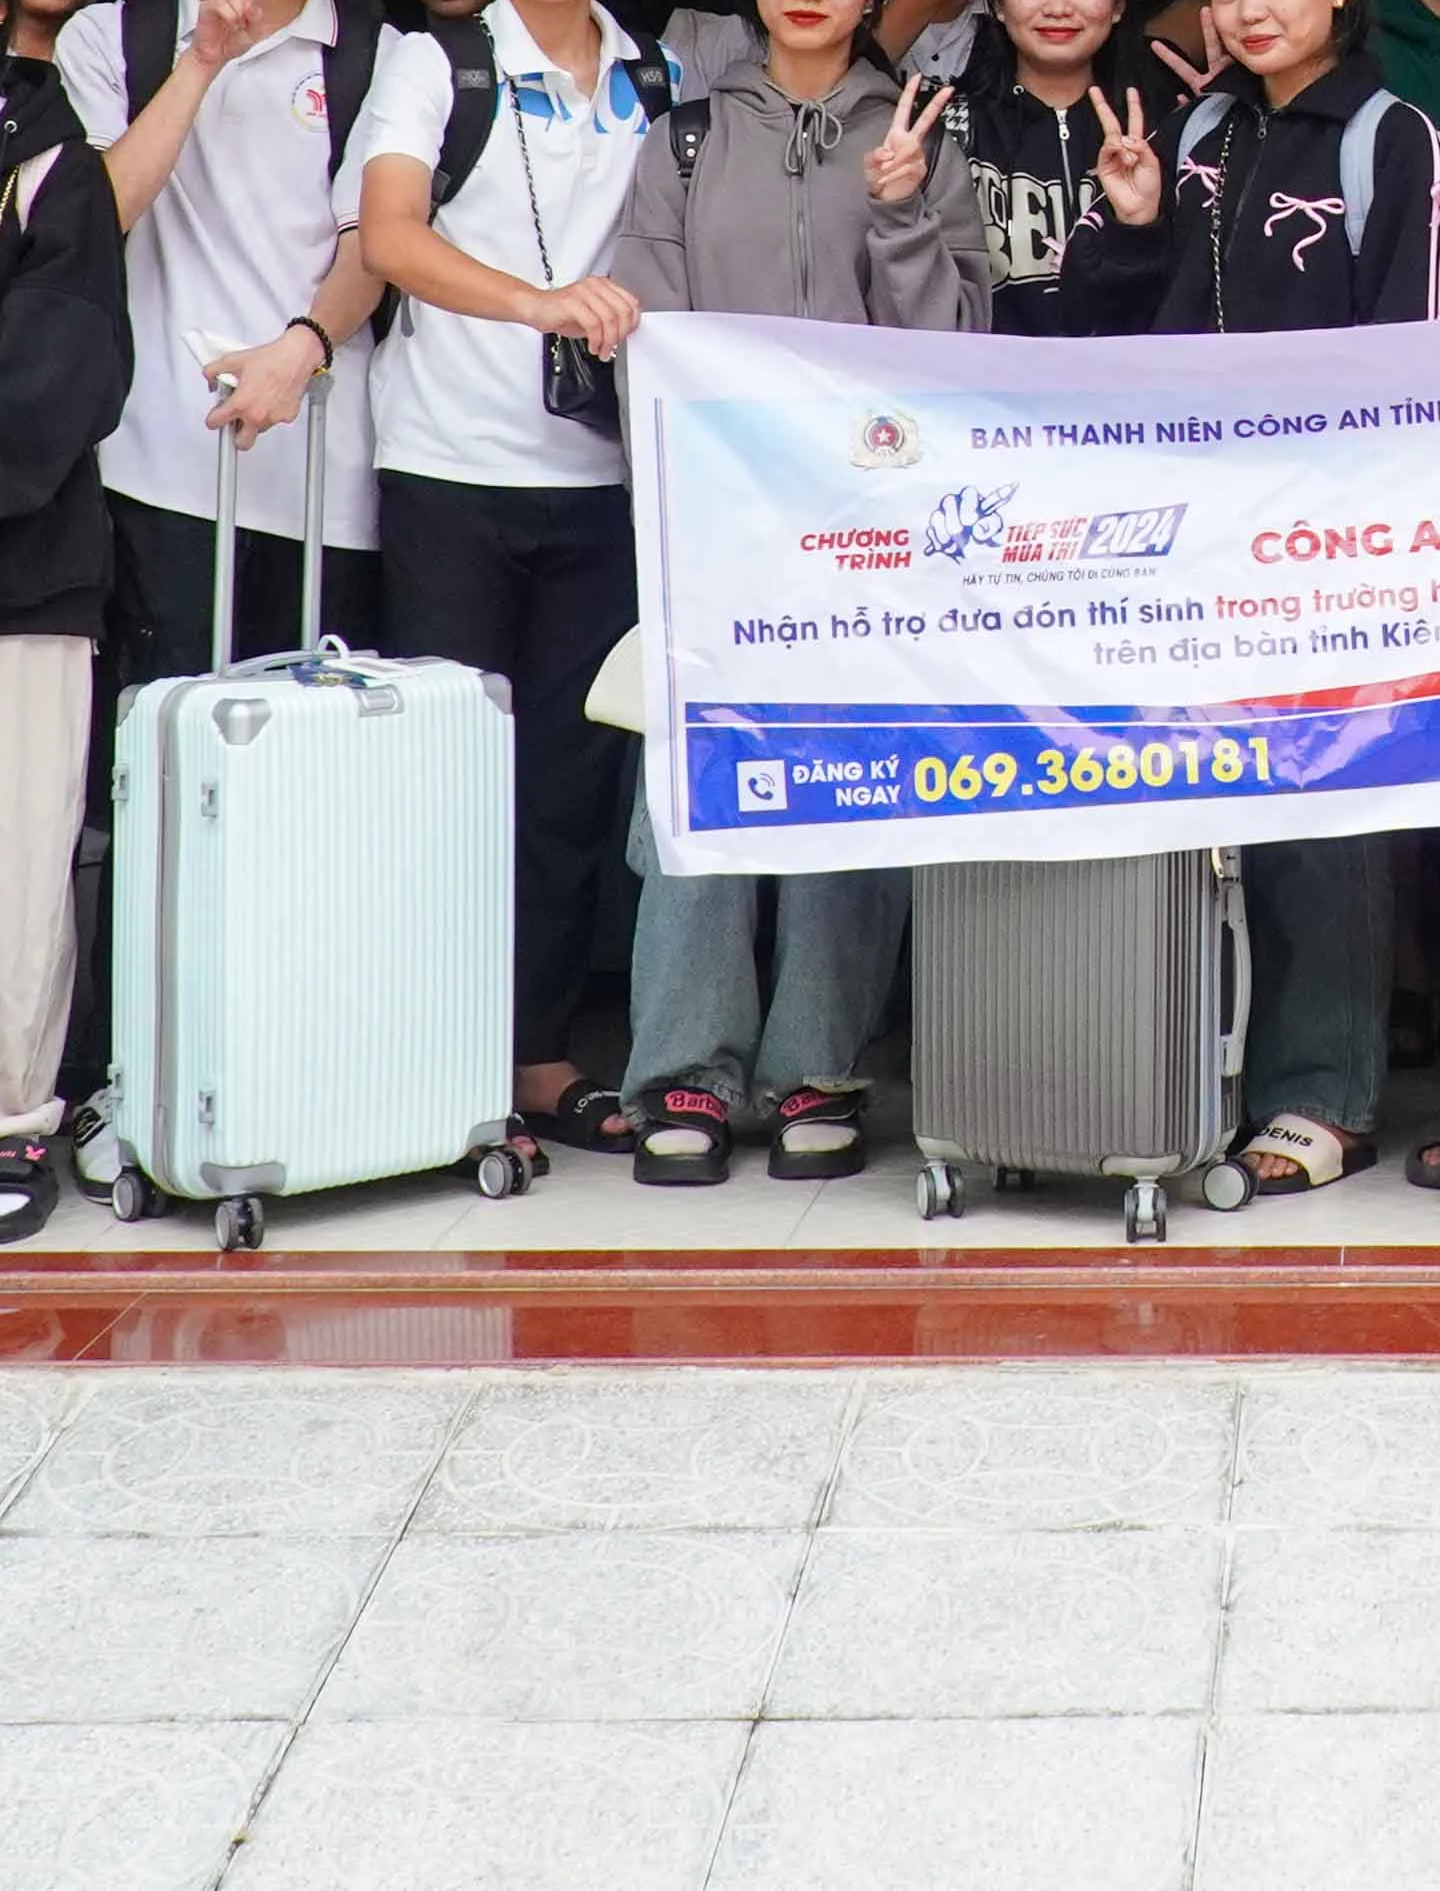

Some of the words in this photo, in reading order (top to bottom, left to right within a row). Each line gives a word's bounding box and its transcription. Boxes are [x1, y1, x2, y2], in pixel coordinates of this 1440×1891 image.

[971, 426, 1032, 450] BAN
[1046, 423, 1144, 447] THANH
[1156, 415, 1222, 443] NIÊN
[1232, 410, 1328, 439] CÔNG
[1337, 407, 1380, 431] AN
[800, 527, 909, 551] CHƯƠNG
[1047, 540, 1077, 561] THI
[1087, 508, 1176, 555] 2024
[1250, 520, 1393, 565] CÔNG
[835, 550, 912, 570] TRÌNH
[733, 618, 819, 649] Nhận
[831, 606, 872, 639] hỗ
[881, 613, 927, 638] trợ
[938, 607, 1002, 633] đưa
[1013, 603, 1076, 630] đón
[1088, 597, 1130, 627] thí
[1139, 597, 1204, 624] sinh
[1215, 594, 1302, 621] trong
[1313, 584, 1420, 614] trường
[1094, 640, 1157, 666] trên
[1169, 636, 1224, 667] địa
[1234, 631, 1298, 657] bàn
[1310, 625, 1368, 654] tỉnh
[792, 762, 863, 785] ĐĂNG
[870, 755, 901, 779] KÝ
[914, 738, 1270, 803] 069.3680181
[835, 783, 902, 808] NGAY
